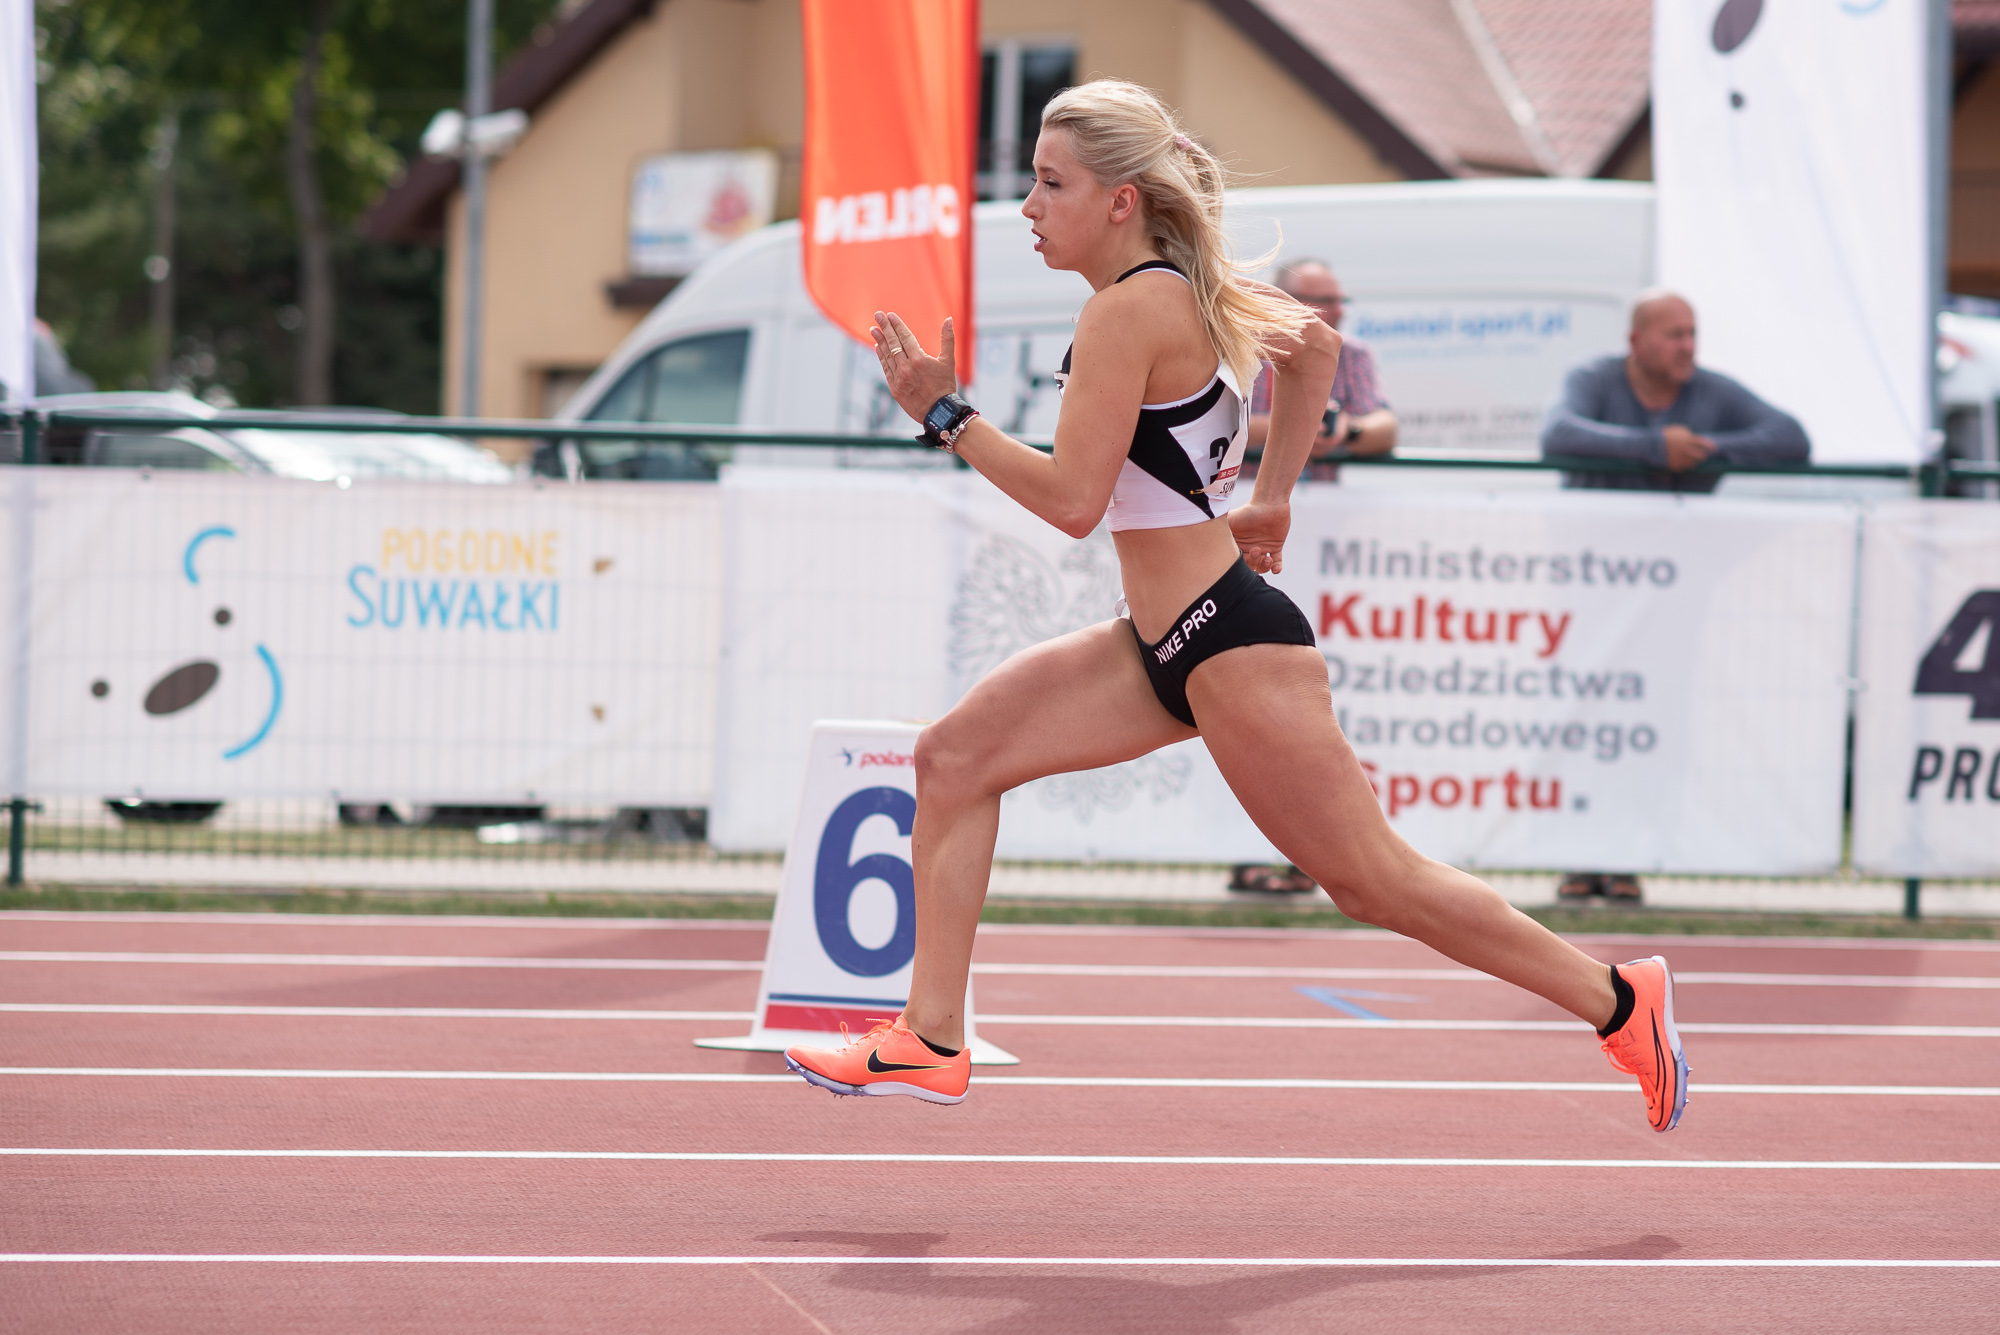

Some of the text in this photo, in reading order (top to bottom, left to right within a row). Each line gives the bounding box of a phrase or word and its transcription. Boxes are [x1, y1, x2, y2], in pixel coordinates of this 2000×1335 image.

[382, 530, 559, 574] POGODNE
[1319, 540, 1679, 587] Ministerstwo
[347, 564, 558, 630] SUWAŁKI
[1319, 592, 1572, 658] Kultury
[1154, 599, 1217, 664] NIKE PRO
[1324, 655, 1646, 699] Dziedzictwa
[814, 786, 916, 978] 6
